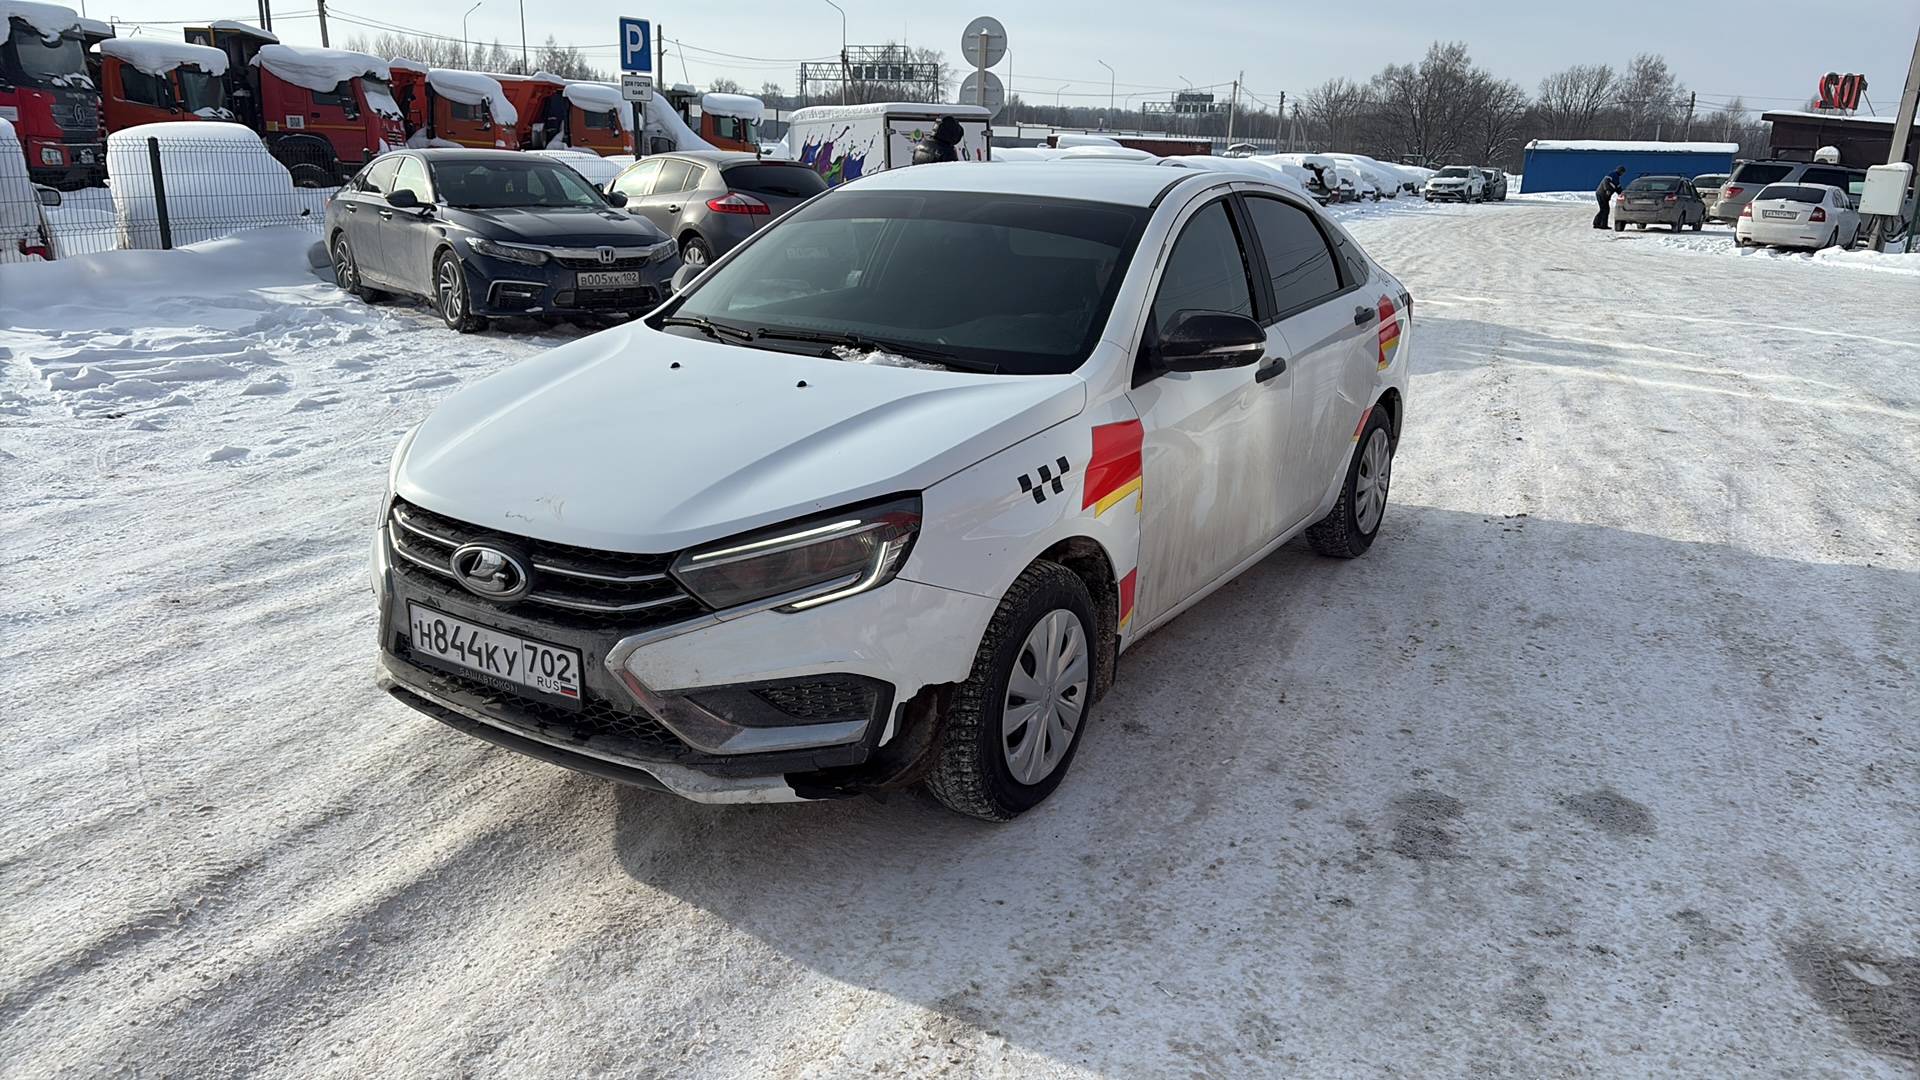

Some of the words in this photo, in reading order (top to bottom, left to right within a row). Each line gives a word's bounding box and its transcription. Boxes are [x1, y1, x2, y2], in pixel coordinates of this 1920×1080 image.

[626, 24, 643, 64] P
[623, 272, 637, 282] 102
[524, 644, 571, 683] 702
[537, 676, 560, 691] RUS
